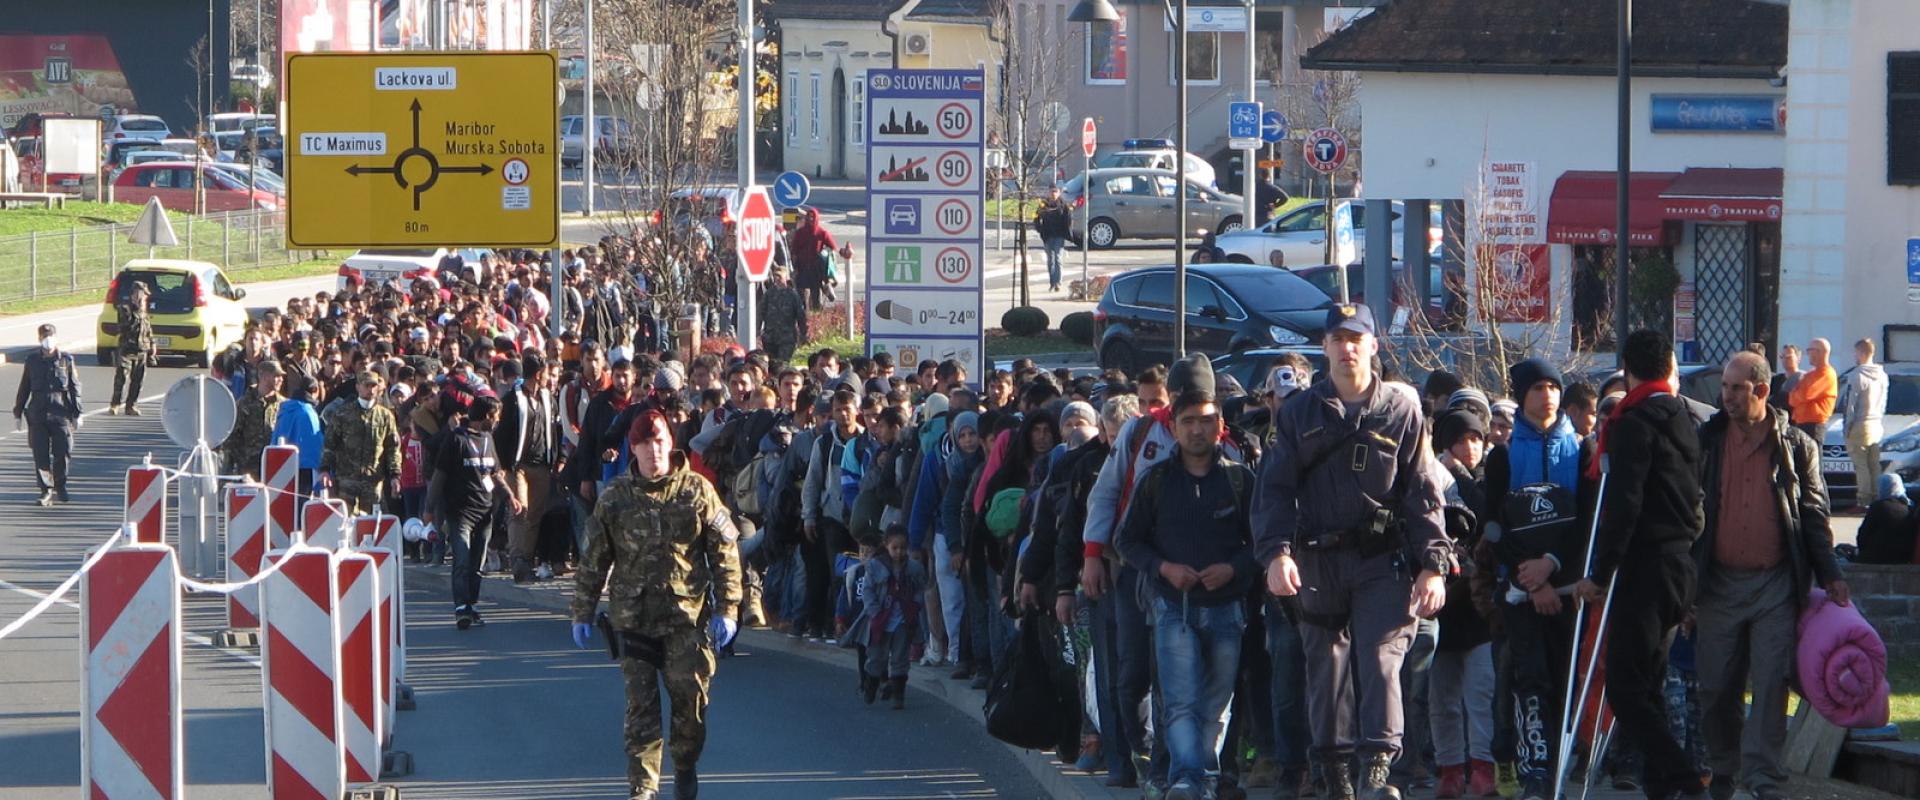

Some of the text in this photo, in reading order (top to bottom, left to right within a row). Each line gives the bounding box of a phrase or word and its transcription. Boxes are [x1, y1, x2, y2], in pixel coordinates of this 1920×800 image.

[48, 62, 68, 81] AVE
[378, 71, 452, 86] Lackova ul.
[874, 75, 961, 90] SLO SLOVENIJA
[446, 121, 496, 136] Maribor
[943, 111, 965, 130] 50
[305, 137, 382, 151] TC Maximus
[446, 140, 545, 155] Murska Sobota
[1318, 143, 1332, 160] T
[943, 159, 965, 178] 90
[944, 208, 964, 226] 110
[742, 217, 771, 251] STOP
[941, 257, 966, 274] 130
